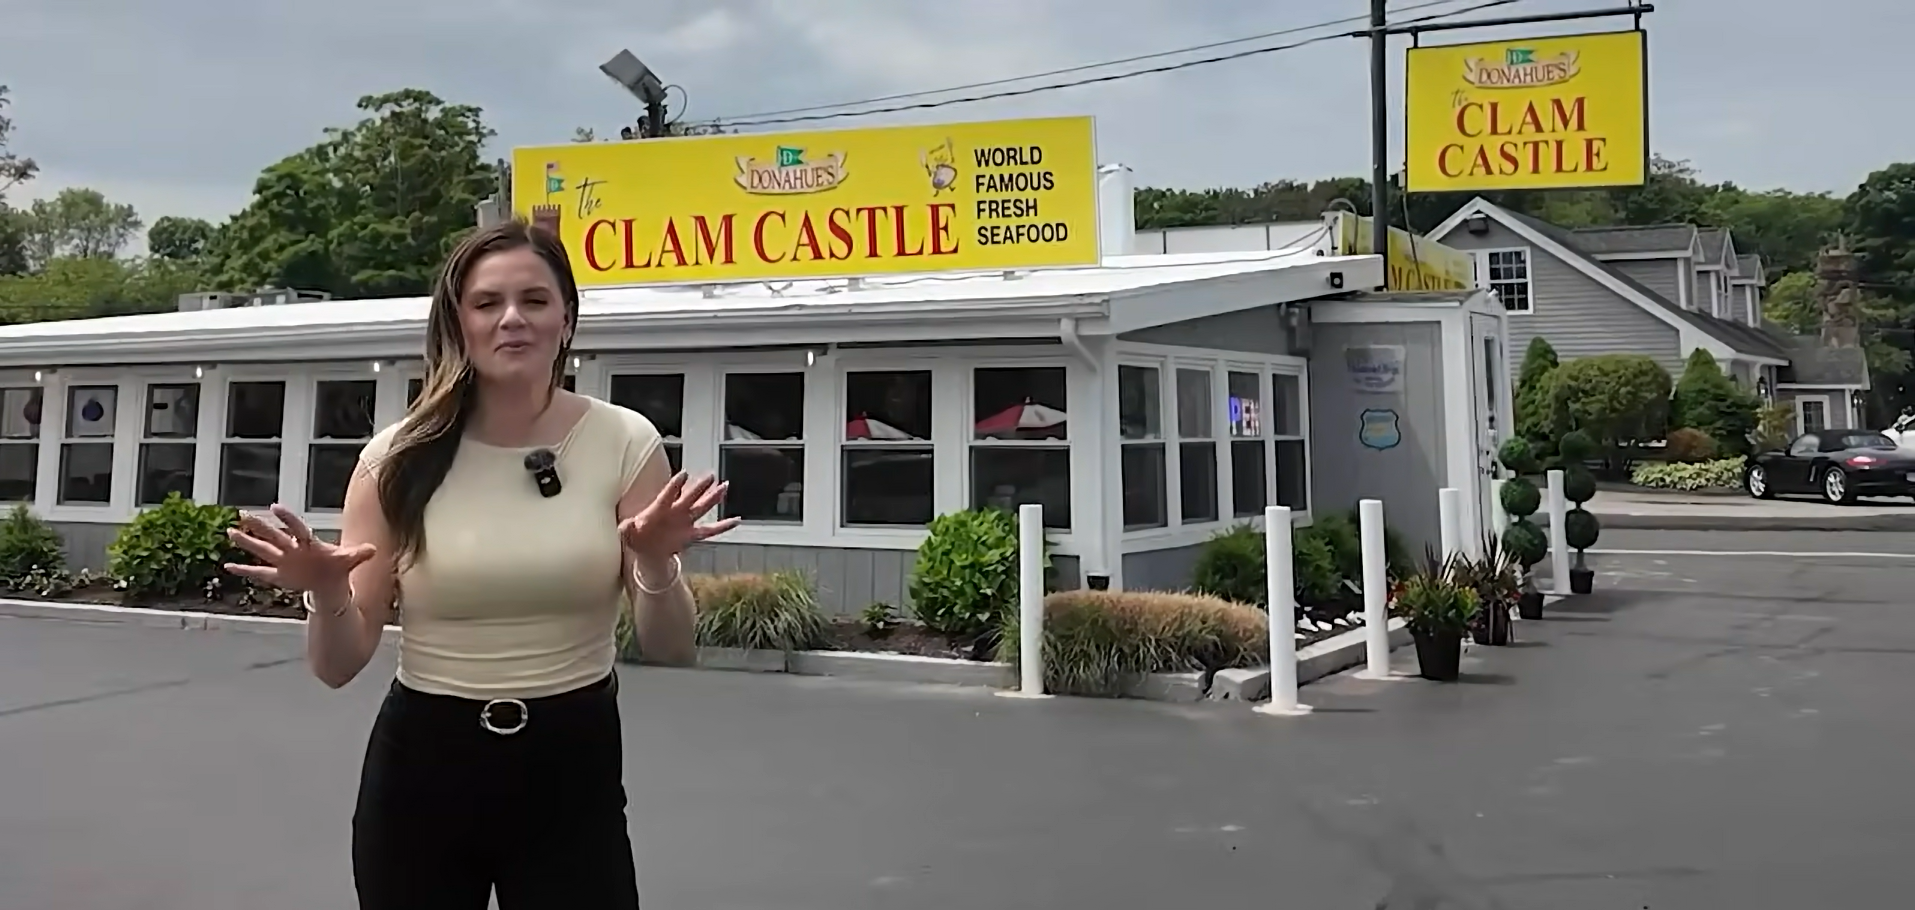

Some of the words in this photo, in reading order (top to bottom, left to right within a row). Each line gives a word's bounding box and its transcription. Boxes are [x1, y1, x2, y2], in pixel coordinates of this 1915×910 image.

[1478, 62, 1567, 85] DONAHUE'S
[1456, 96, 1587, 137] CLAM
[782, 150, 793, 165] D
[974, 146, 1042, 168] WORLD
[1438, 137, 1608, 178] CASTLE
[750, 165, 836, 190] DONAHUE'S
[975, 171, 1055, 193] FAMOUS
[575, 177, 608, 219] the
[977, 198, 1038, 219] FRESH
[584, 213, 738, 272] CLAM
[753, 203, 960, 264] CASTLE
[977, 222, 1068, 245] SEAFOOD
[1230, 397, 1260, 435] PEN
